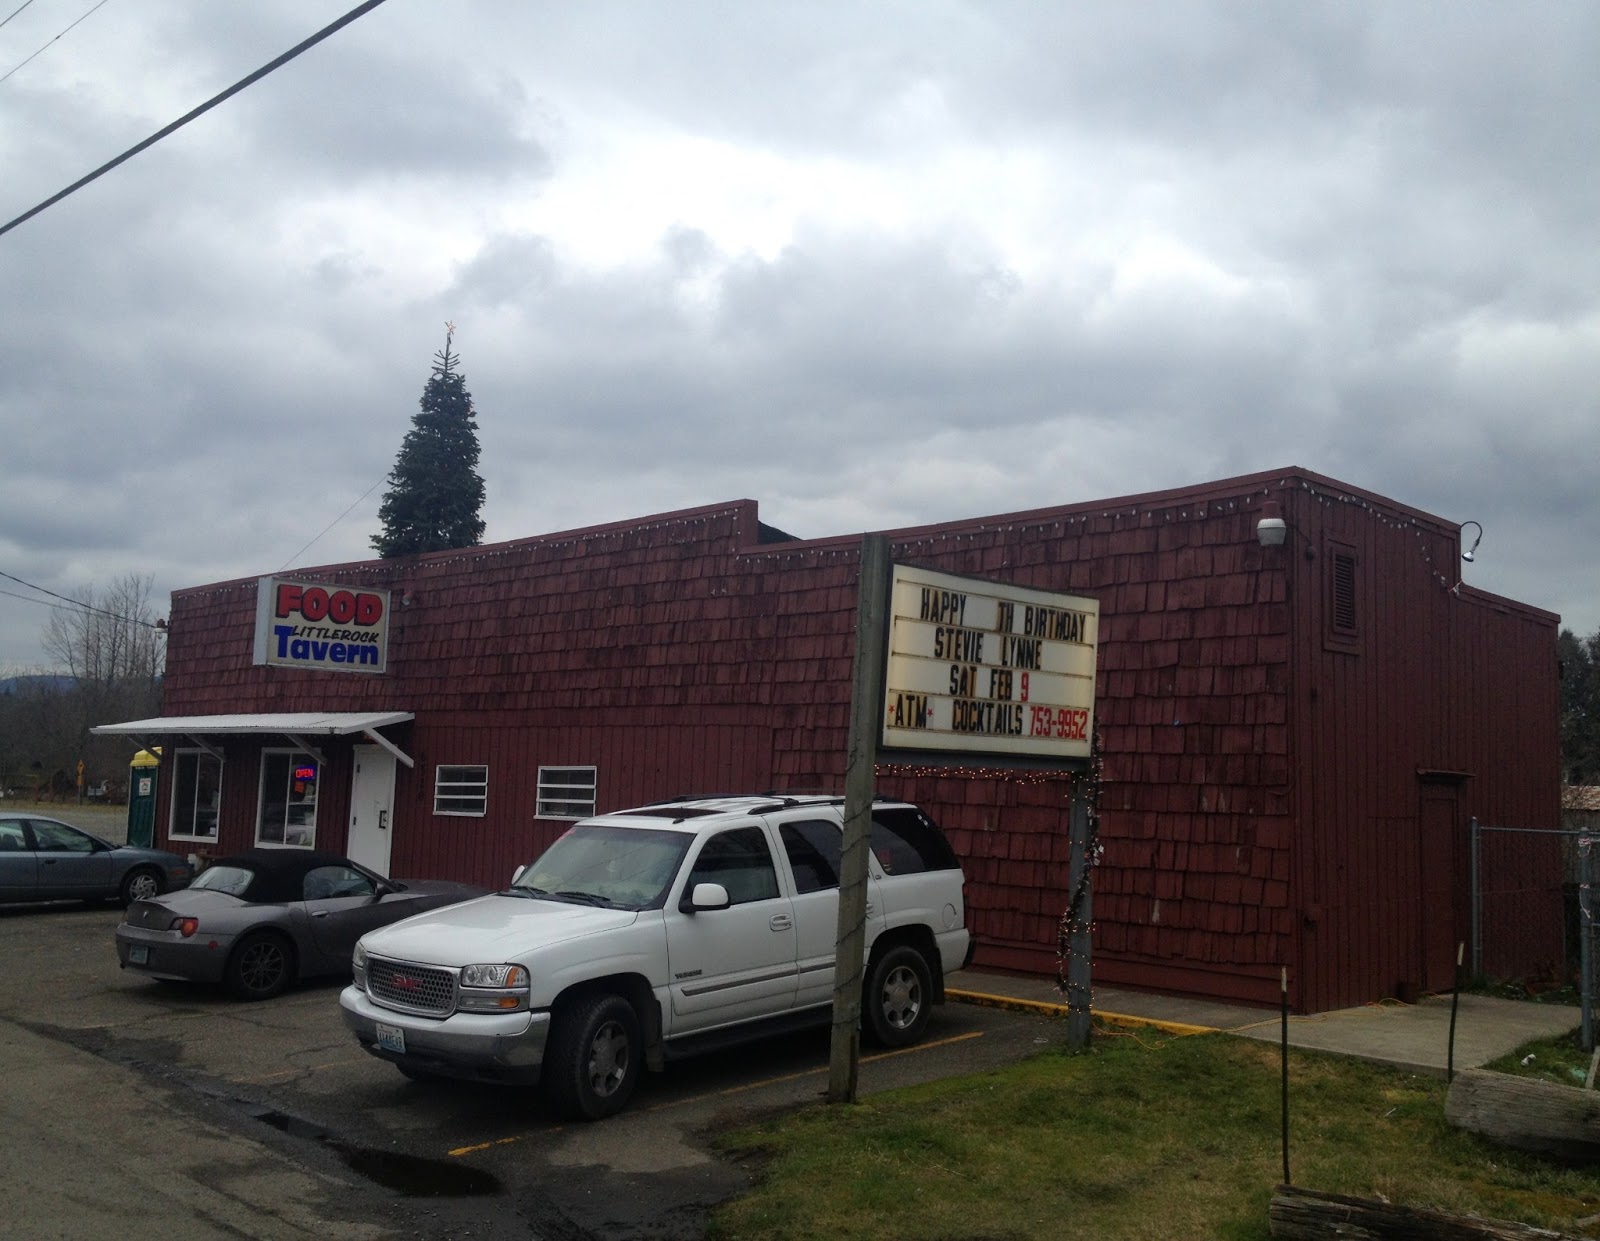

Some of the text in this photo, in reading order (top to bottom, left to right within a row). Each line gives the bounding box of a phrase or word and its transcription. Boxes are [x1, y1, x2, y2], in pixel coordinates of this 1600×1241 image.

[275, 584, 383, 626] FOOD
[920, 588, 1086, 642] HAPPY TH BIRTHDAY
[274, 625, 379, 665] Tavern
[292, 625, 379, 643] LITTLEROCK
[934, 627, 1042, 670] STEVIE LYNNE
[950, 665, 1029, 701] SAT FEB 9
[952, 700, 1023, 735] COCKTAILS
[1030, 706, 1088, 739] 753-9952
[295, 769, 314, 778] OPEN
